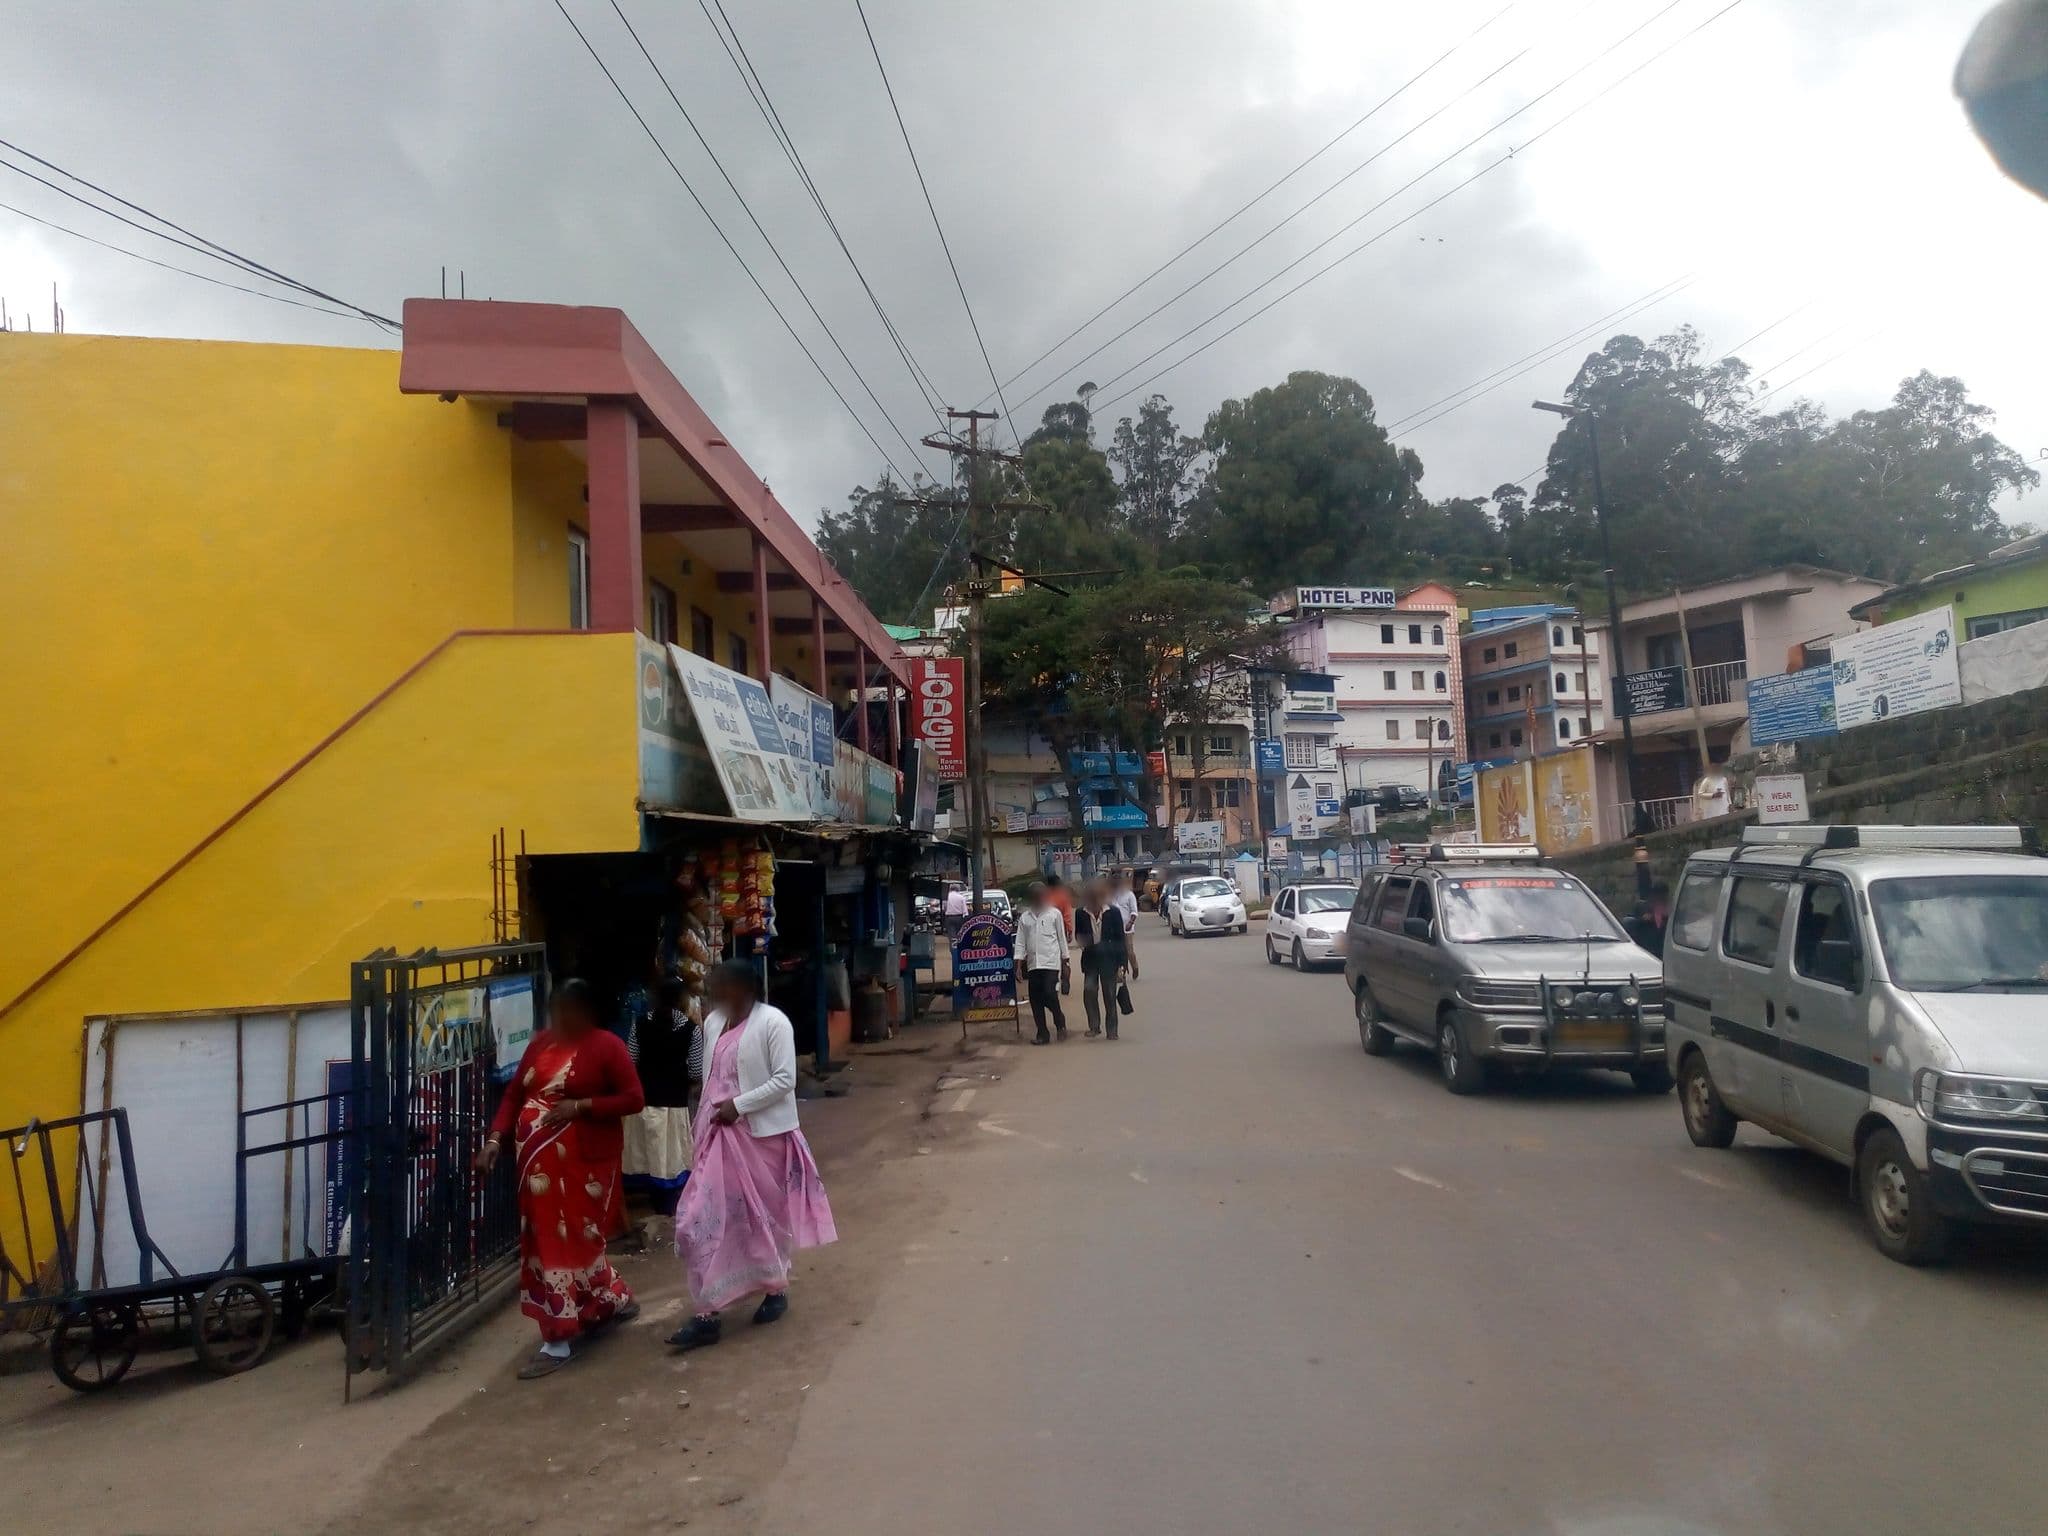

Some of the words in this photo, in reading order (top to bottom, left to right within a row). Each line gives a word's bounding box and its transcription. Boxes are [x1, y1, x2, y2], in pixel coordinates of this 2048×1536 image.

[1301, 590, 1355, 604] HOTEL
[1360, 591, 1394, 604] PNR
[746, 691, 772, 720] elite
[921, 660, 954, 756] LODGE
[814, 711, 831, 736] elite
[1766, 804, 1782, 812] SEAT
[1783, 803, 1799, 811] BELT
[1771, 792, 1793, 800] WEAR
[327, 1180, 335, 1219] Ettines
[326, 1220, 334, 1249] Road
